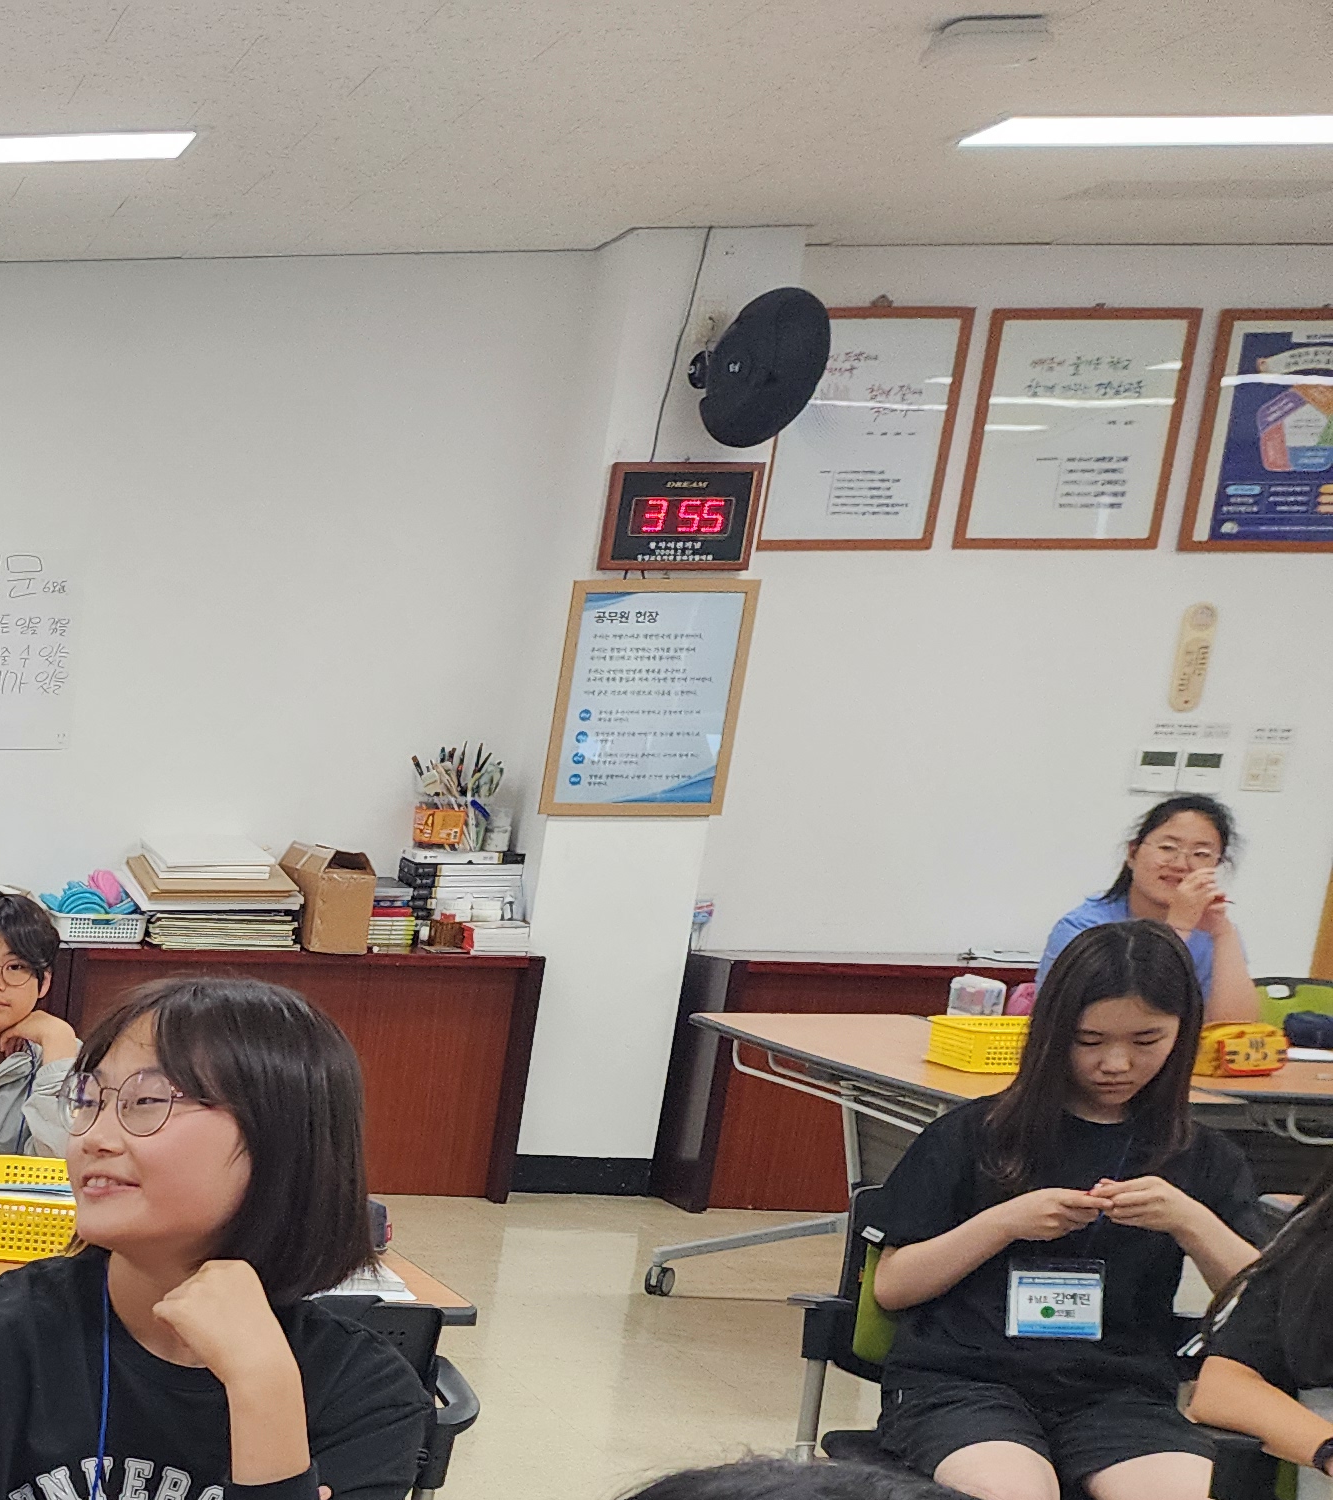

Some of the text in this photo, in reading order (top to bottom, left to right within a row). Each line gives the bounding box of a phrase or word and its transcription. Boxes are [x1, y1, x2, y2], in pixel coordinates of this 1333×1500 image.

[15, 615, 42, 636] 일을
[593, 610, 660, 625] 공무원 헌장
[19, 644, 31, 668] 수
[38, 642, 70, 669] 있는
[34, 668, 70, 697] 있을
